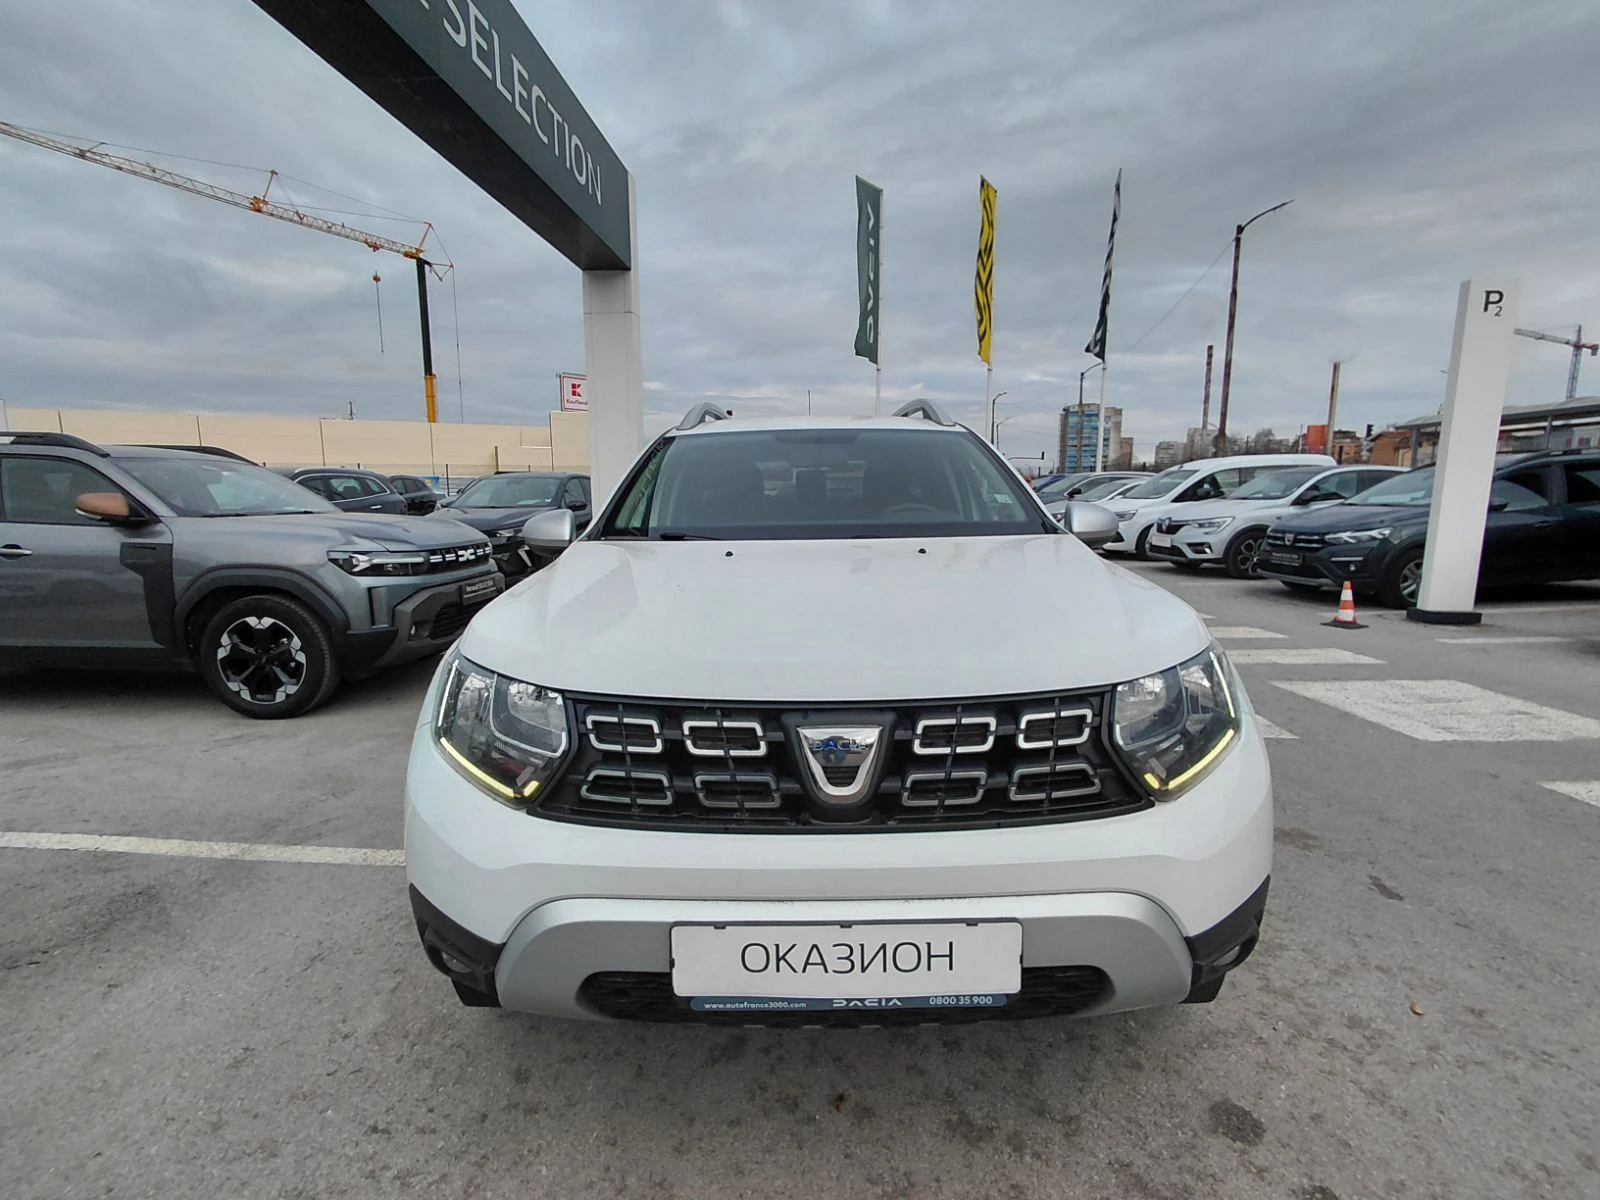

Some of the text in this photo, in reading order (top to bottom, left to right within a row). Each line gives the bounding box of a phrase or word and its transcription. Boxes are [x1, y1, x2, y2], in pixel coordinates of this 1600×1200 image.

[443, 0, 603, 206] SELECTION
[812, 740, 869, 751] DACIA
[740, 941, 954, 974] ОКАЗИОН
[704, 995, 993, 1009] www.autofrance3000.com DACIA 0800 35 900
